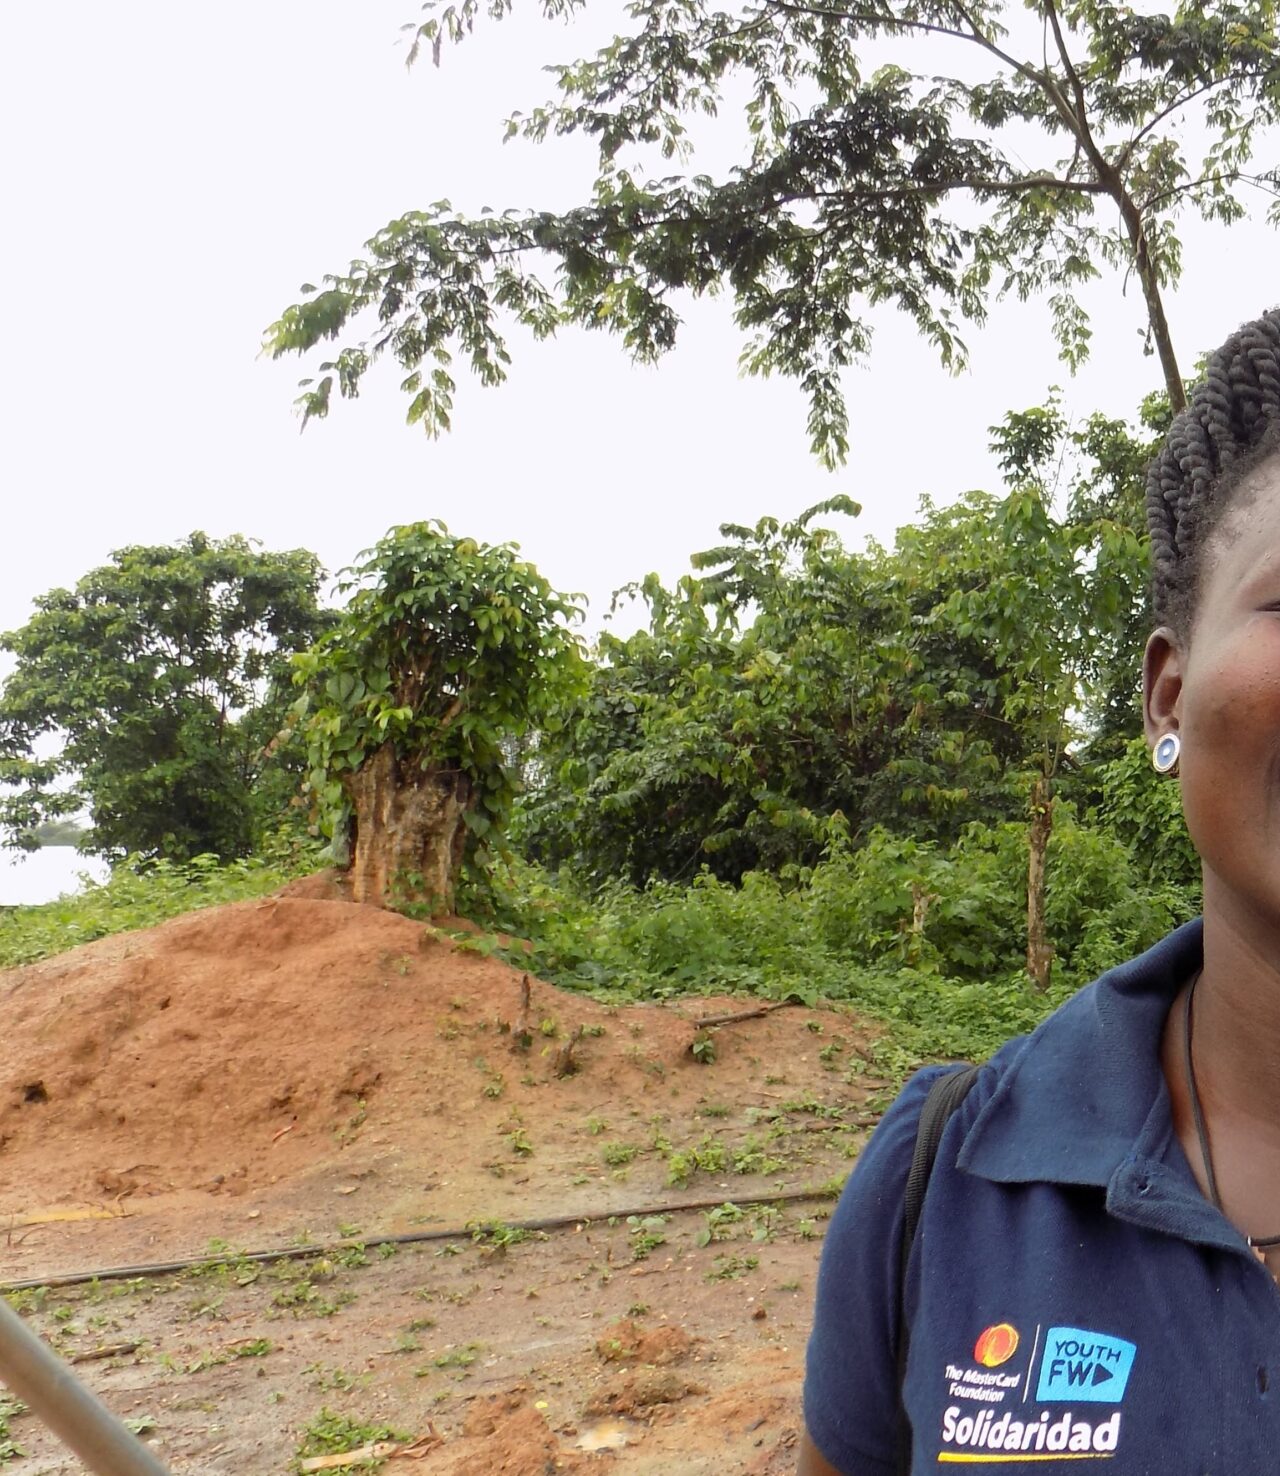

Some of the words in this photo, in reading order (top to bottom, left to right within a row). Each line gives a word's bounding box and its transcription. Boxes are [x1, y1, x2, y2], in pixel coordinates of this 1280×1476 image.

[1055, 1341, 1121, 1362] YOUTH
[945, 1366, 960, 1379] The
[963, 1370, 1020, 1387] MasterCard
[949, 1384, 1005, 1402] Foundation
[942, 1407, 1121, 1451] Solidaridad
